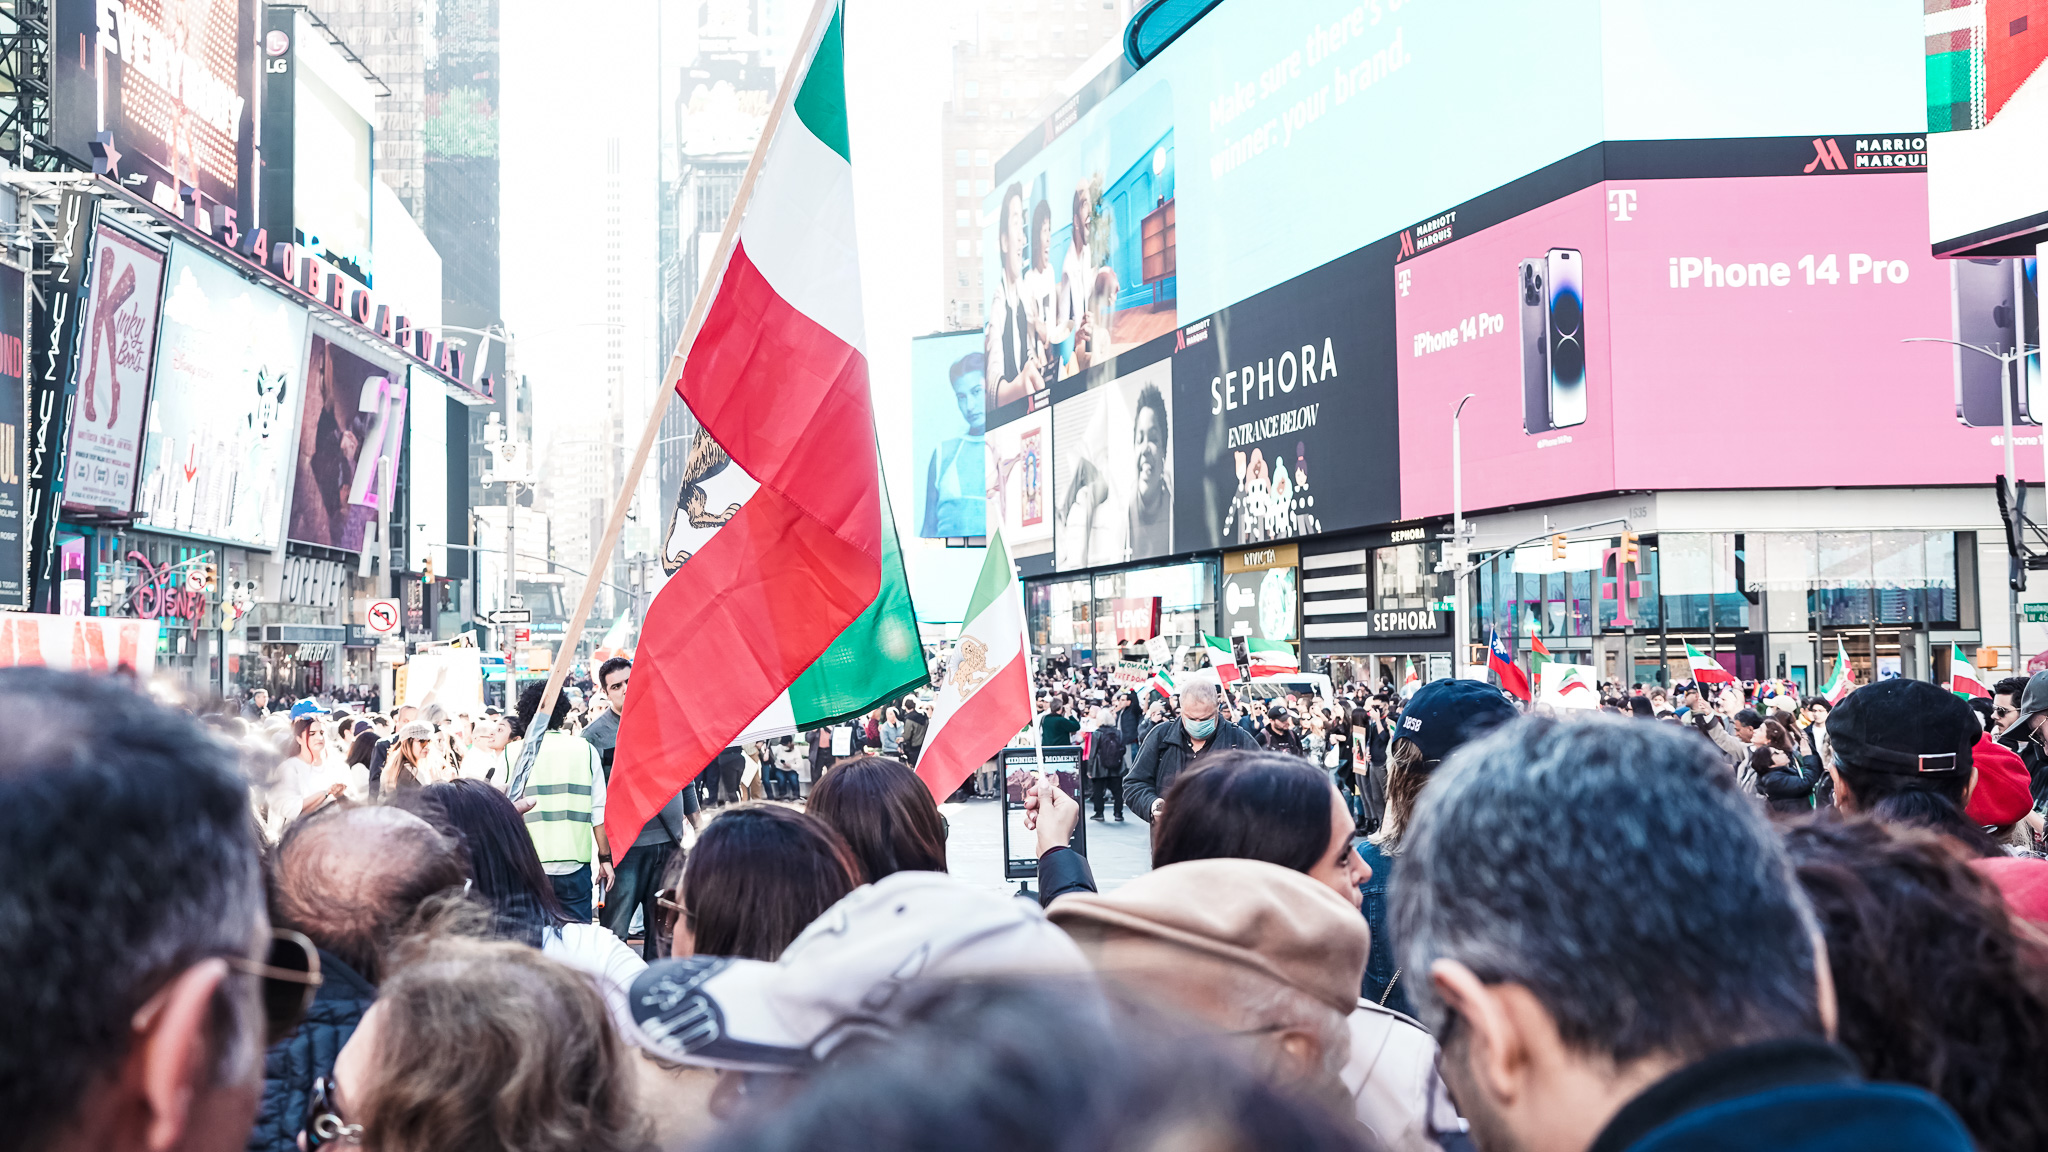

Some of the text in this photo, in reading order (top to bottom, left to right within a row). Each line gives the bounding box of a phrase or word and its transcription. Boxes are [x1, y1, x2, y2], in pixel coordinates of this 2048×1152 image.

[266, 58, 288, 74] LG
[1209, 0, 1382, 133] Make sure there's
[1209, 26, 1411, 181] winner: your brand.
[1855, 138, 1927, 152] MARRIO
[1856, 153, 1926, 167] MARQUI
[1416, 211, 1457, 237] MARRIOTT
[1417, 227, 1452, 250] MARQUIS
[1669, 253, 1909, 288] iPhone 14 Pro
[182, 187, 466, 380] 1540 BROADWAY
[1413, 312, 1504, 357] iPhone 14 Pro
[117, 342, 145, 373] Boots
[1211, 337, 1338, 416] SEPHORA
[1228, 403, 1319, 449] ENTRANCE BELOW
[2000, 435, 2038, 446] ihone
[1629, 506, 1647, 519] 1535
[1391, 528, 1425, 542] SEPHORA
[1243, 549, 1276, 566] INVICTA
[2024, 603, 2048, 613] Broadwa
[1374, 611, 1436, 631] SEPHORA
[1118, 660, 1149, 671] WOMAN
[1114, 672, 1148, 683] FREEDOM
[1044, 754, 1079, 763] MOMENT
